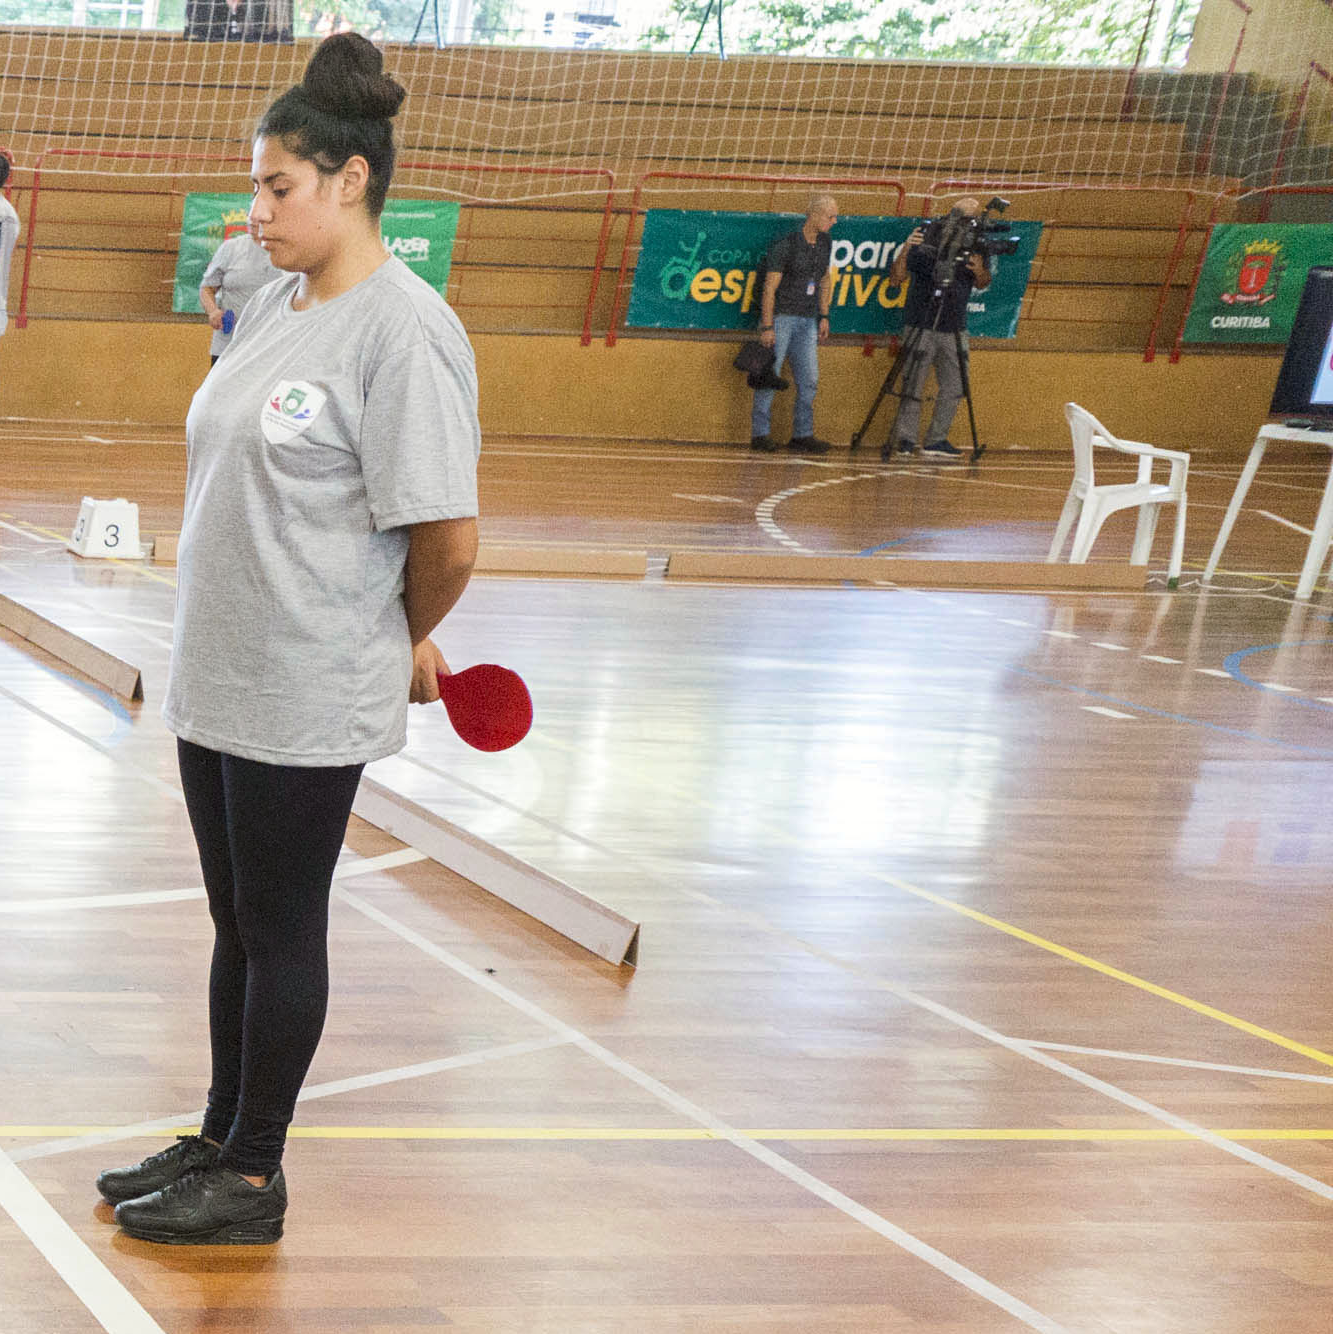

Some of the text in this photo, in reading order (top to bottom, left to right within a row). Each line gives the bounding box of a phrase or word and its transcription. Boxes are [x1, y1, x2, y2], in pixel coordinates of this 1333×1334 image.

[829, 239, 906, 272] par
[1210, 315, 1271, 329] CURITIBA
[104, 524, 120, 548] 3
